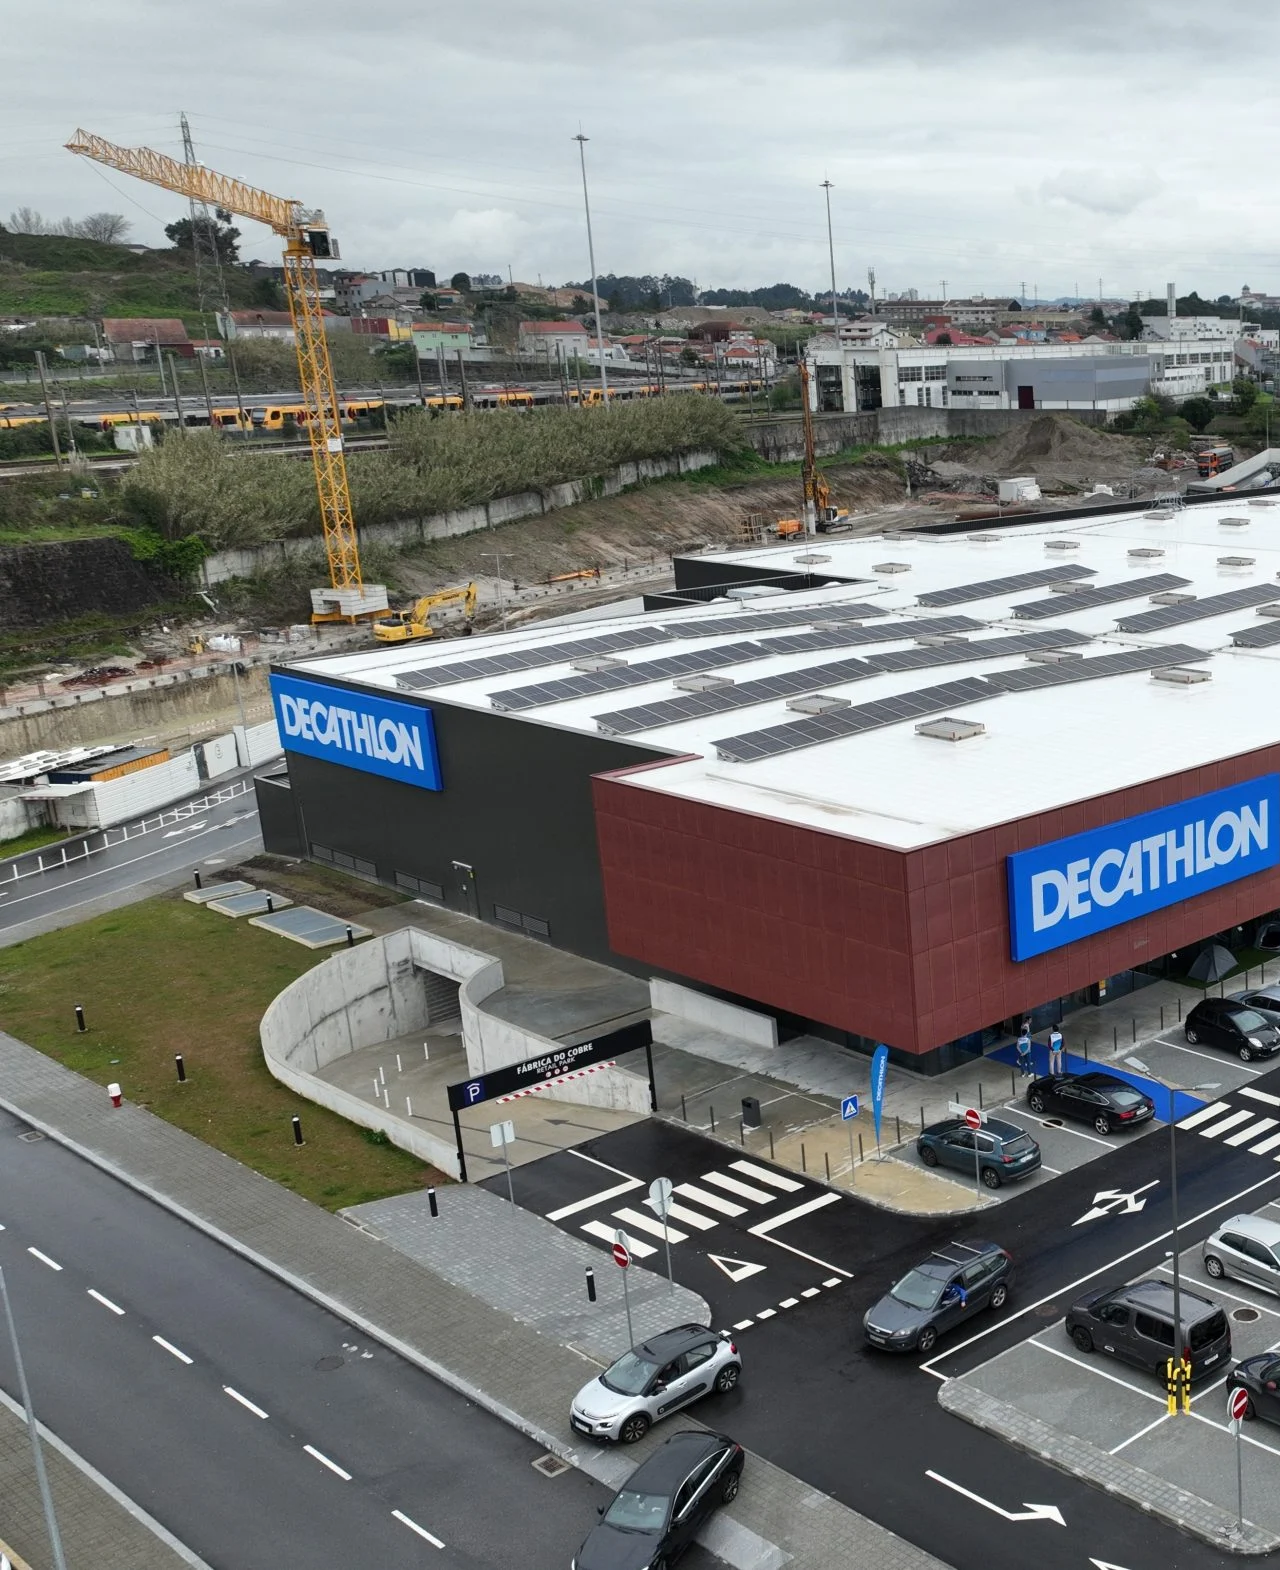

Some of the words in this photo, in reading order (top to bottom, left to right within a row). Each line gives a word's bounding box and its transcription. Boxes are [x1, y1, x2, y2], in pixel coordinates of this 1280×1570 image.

[280, 693, 424, 770] DECATHLON
[1031, 799, 1268, 933] DECATHLON
[516, 1057, 552, 1075] FÁBRICA
[554, 1052, 566, 1063] DO
[567, 1043, 593, 1057] COBRE
[536, 1065, 557, 1075] RETAIL
[559, 1057, 576, 1067] PARK
[876, 1055, 886, 1102] DECATHLON
